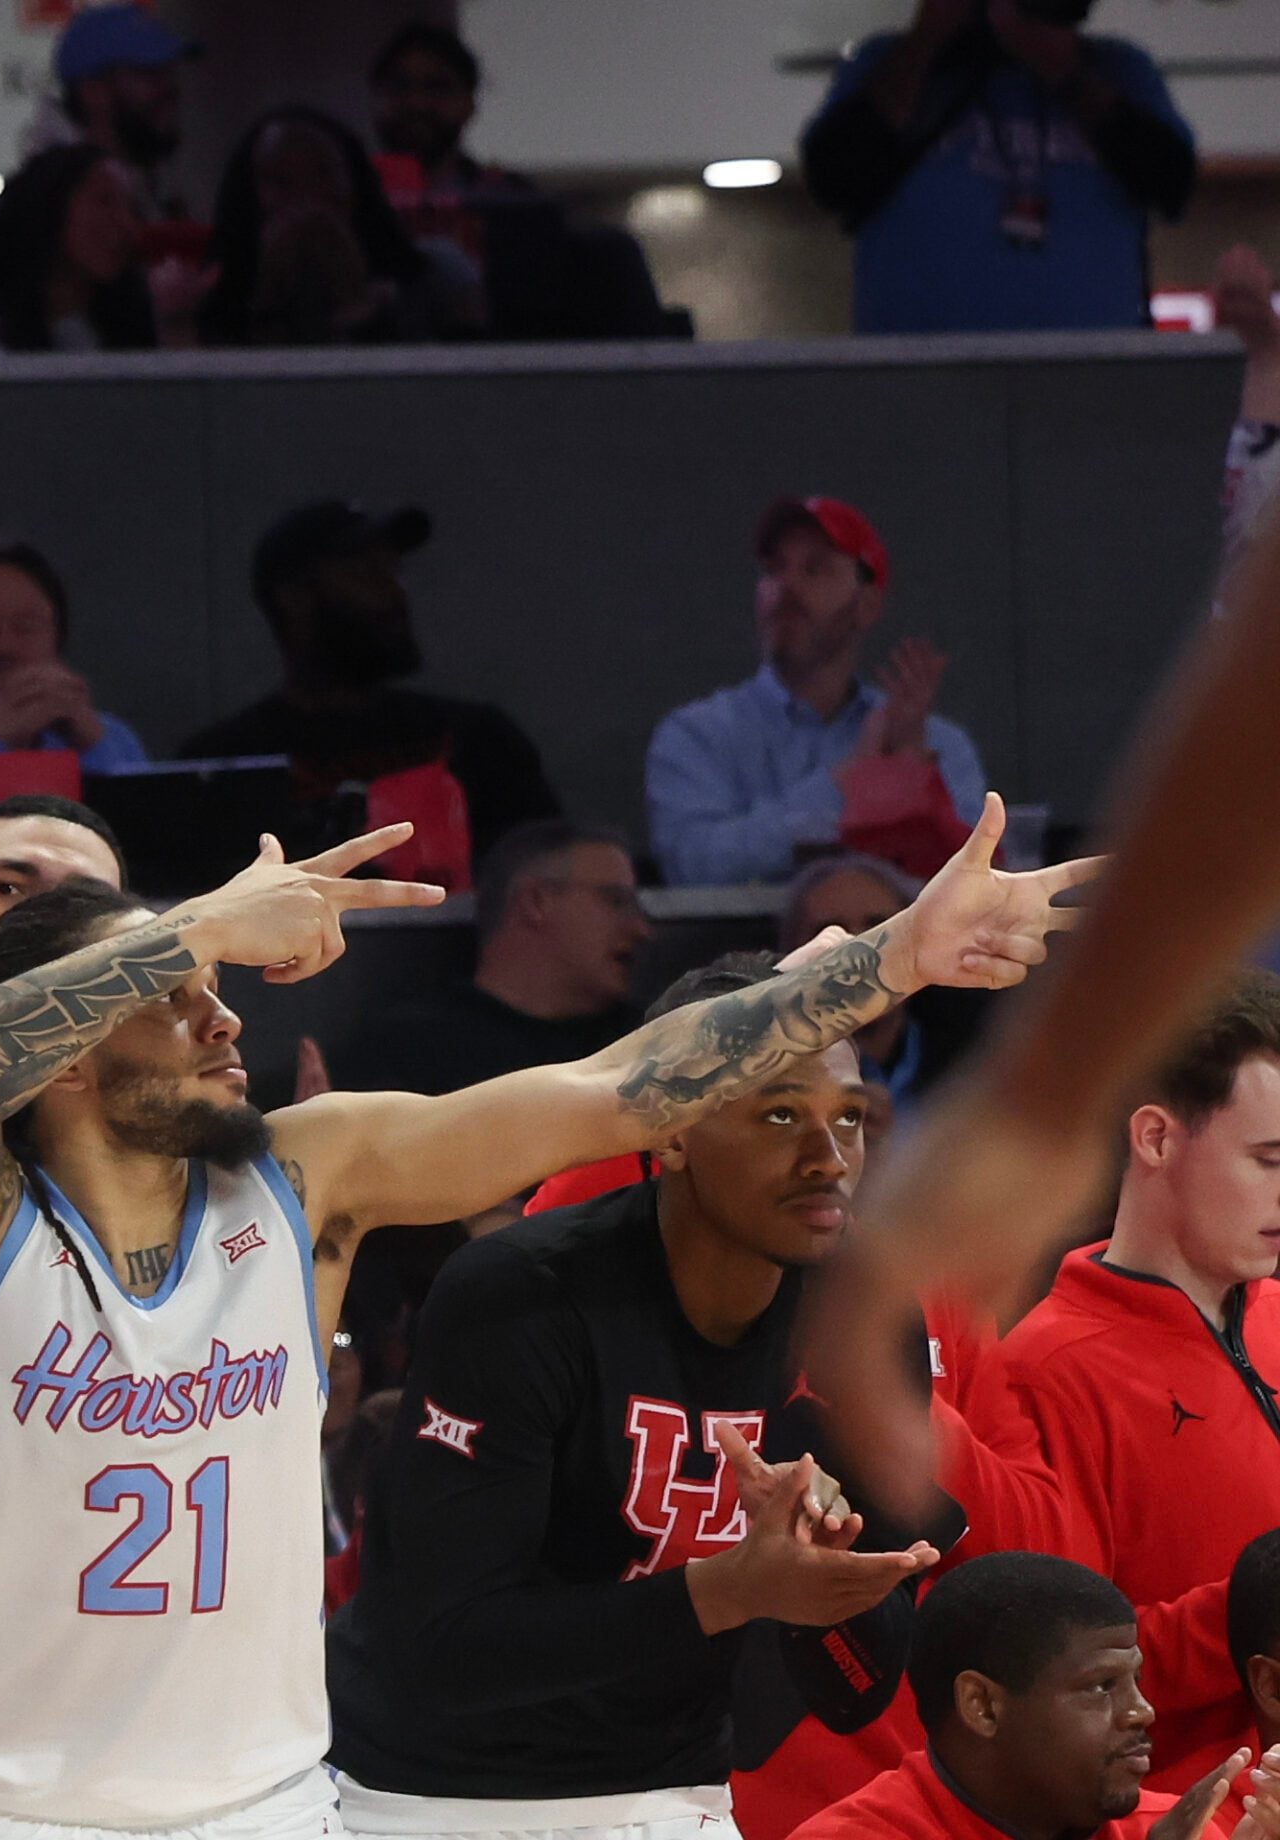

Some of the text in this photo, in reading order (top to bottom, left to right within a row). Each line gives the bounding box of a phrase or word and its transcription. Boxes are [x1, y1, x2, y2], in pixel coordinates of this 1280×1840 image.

[11, 1319, 288, 1438] Houston
[417, 1397, 485, 1461] XII
[78, 1455, 229, 1616] 21
[620, 1394, 766, 1583] UH
